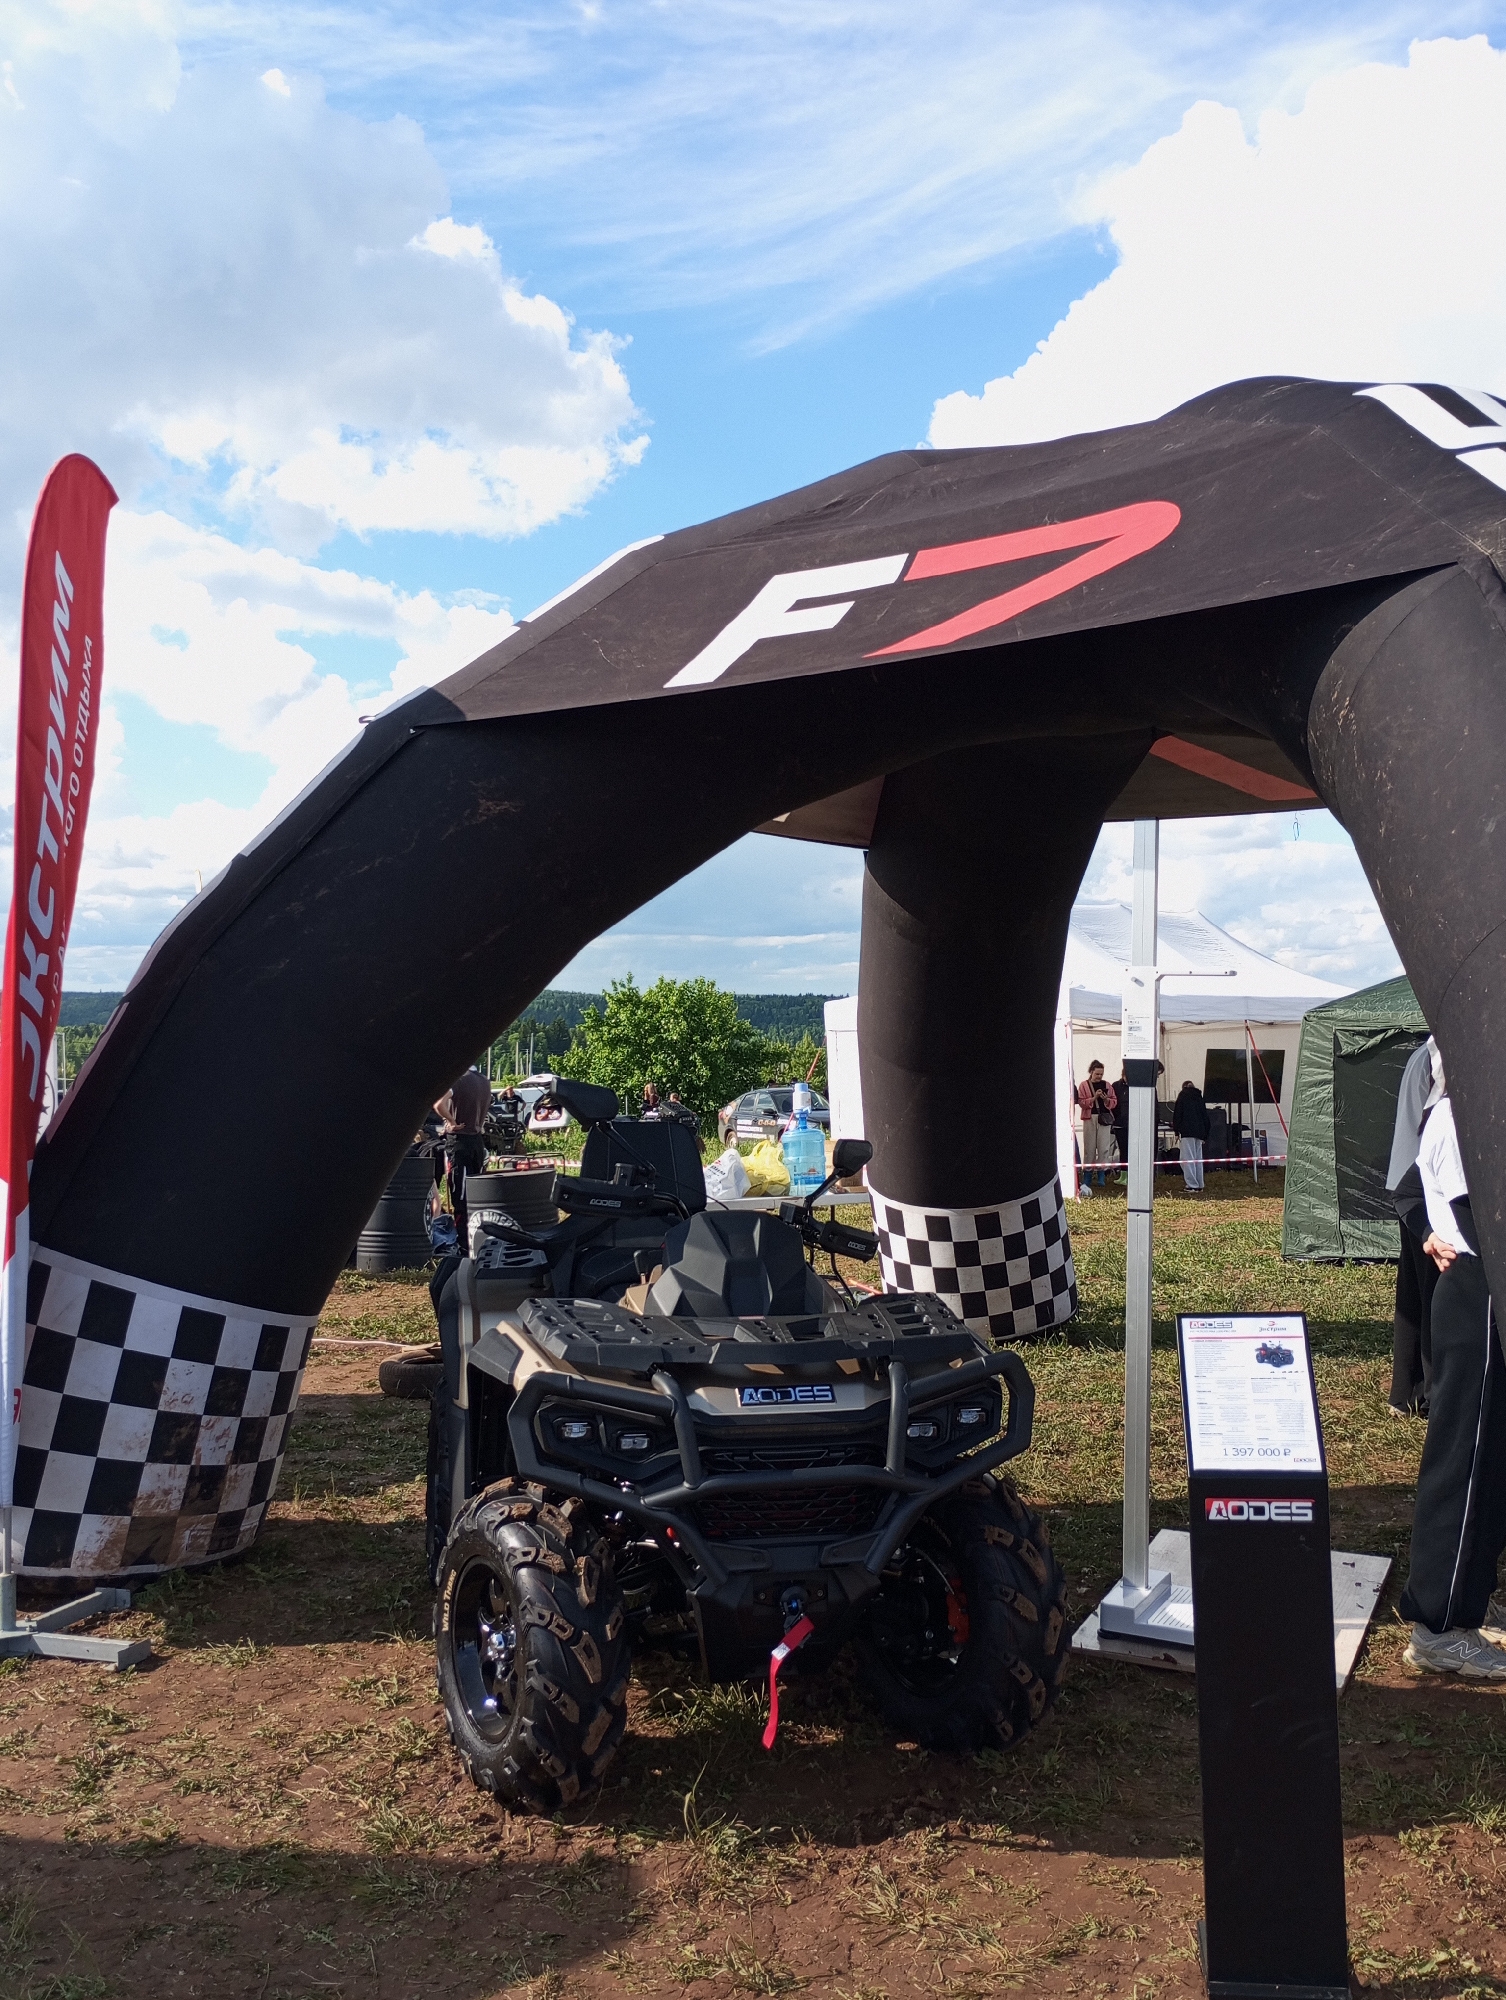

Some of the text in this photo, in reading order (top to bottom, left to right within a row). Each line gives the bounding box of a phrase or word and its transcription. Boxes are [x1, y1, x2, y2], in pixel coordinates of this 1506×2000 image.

[73, 634, 94, 768] ОТДЫХА
[741, 1385, 833, 1404] AODES
[1223, 1448, 1229, 1457] 1
[1232, 1447, 1255, 1457] 397
[1257, 1447, 1280, 1457] 000
[1208, 1500, 1313, 1521] AODES
